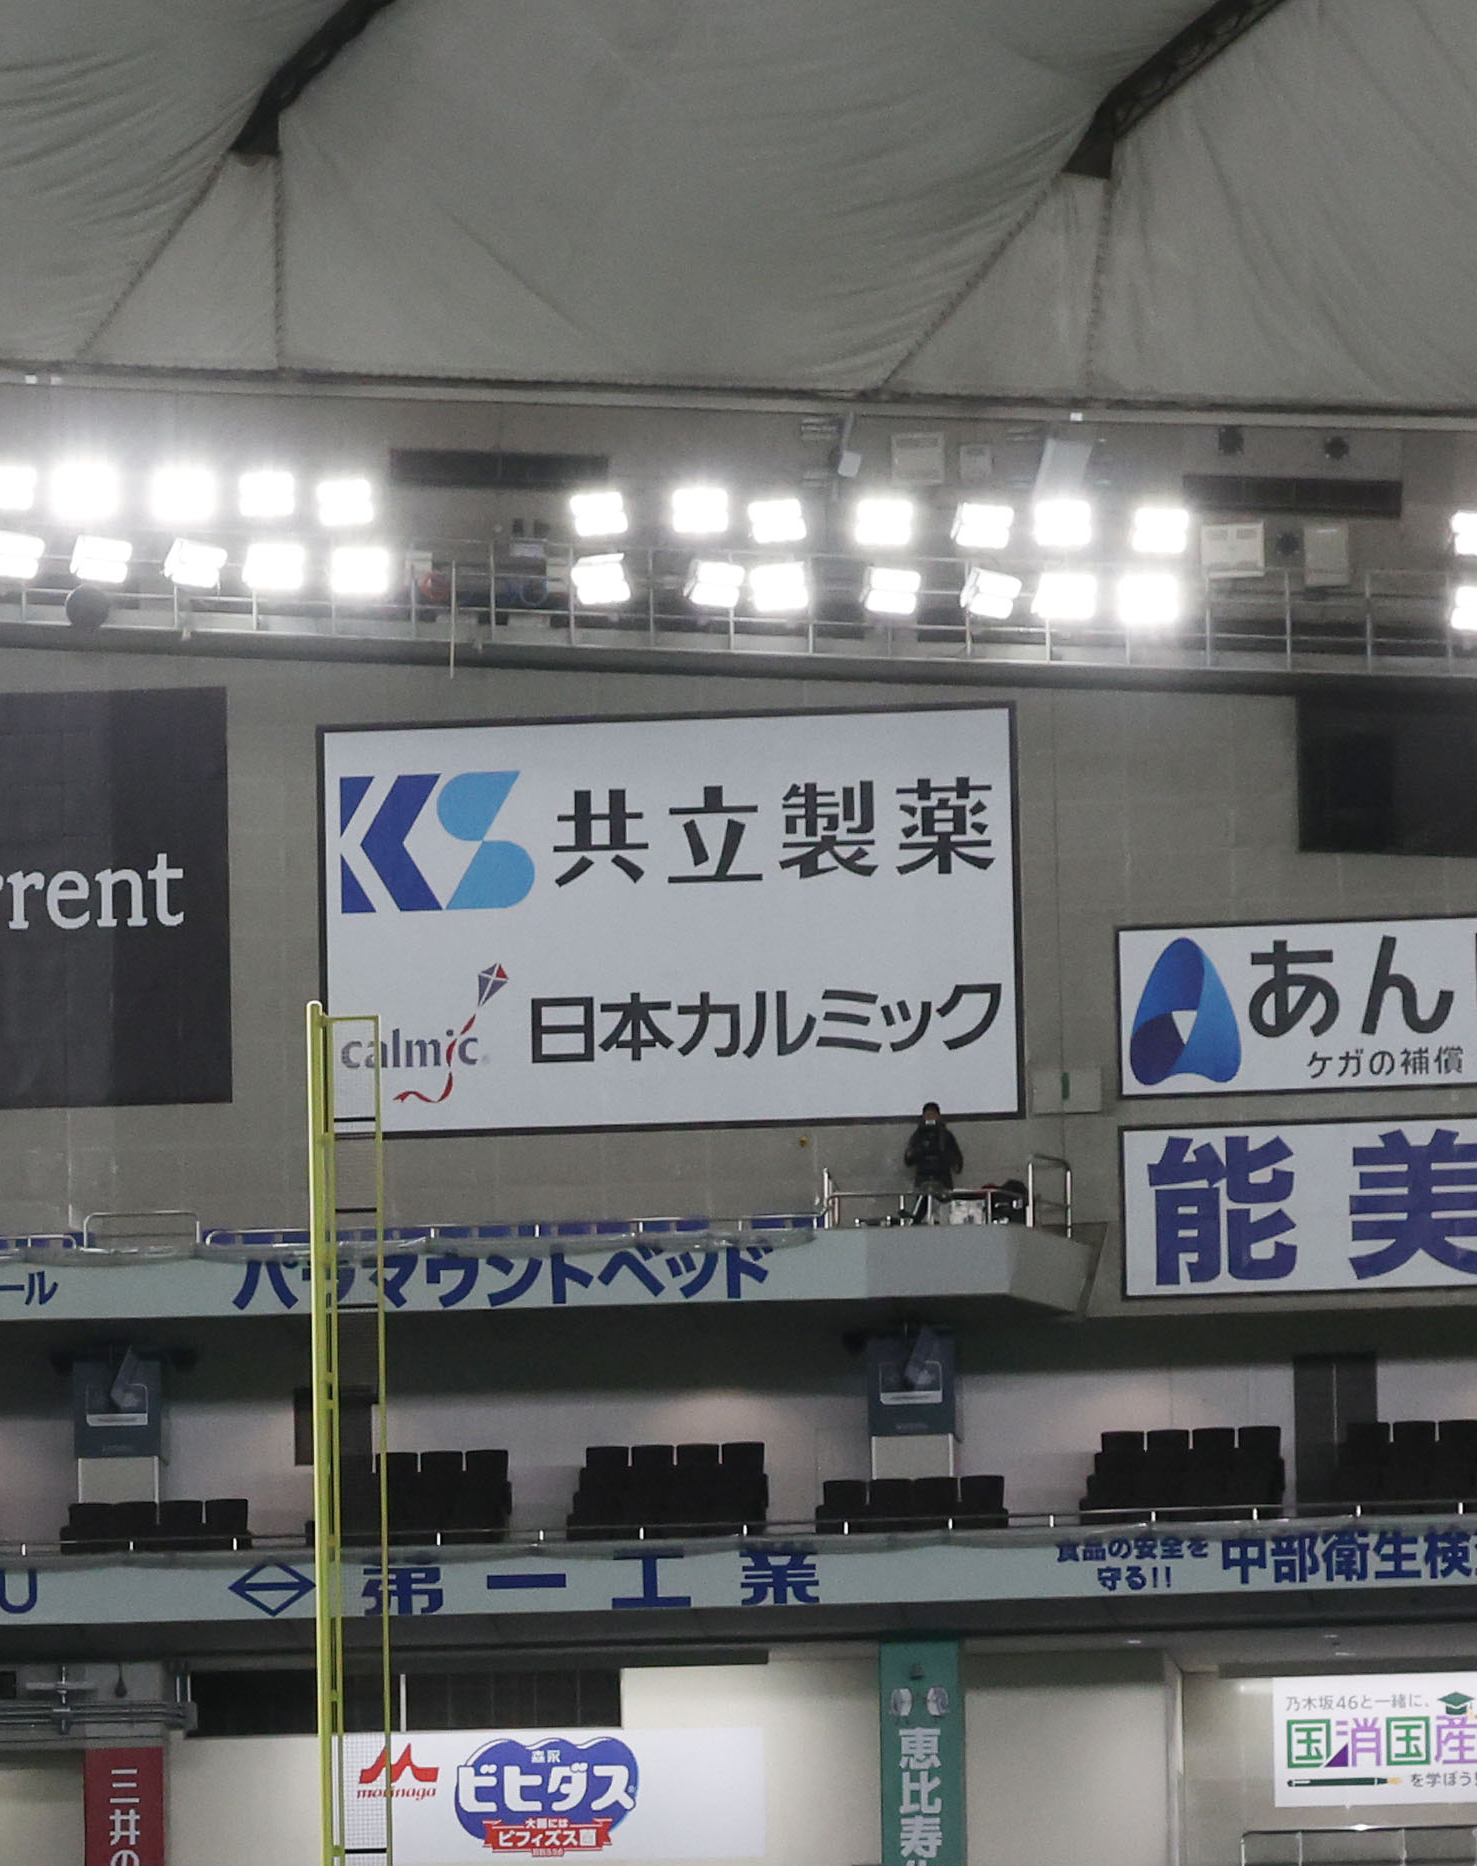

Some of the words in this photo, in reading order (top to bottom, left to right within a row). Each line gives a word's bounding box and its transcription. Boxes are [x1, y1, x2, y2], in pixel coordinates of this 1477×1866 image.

[553, 777, 995, 888] 共立製薬
[340, 1022, 480, 1070] calmic
[531, 984, 1003, 1064] 日本カルミック
[1097, 1565, 1173, 1592] 守る!!
[457, 1762, 636, 1813] ビヒダス
